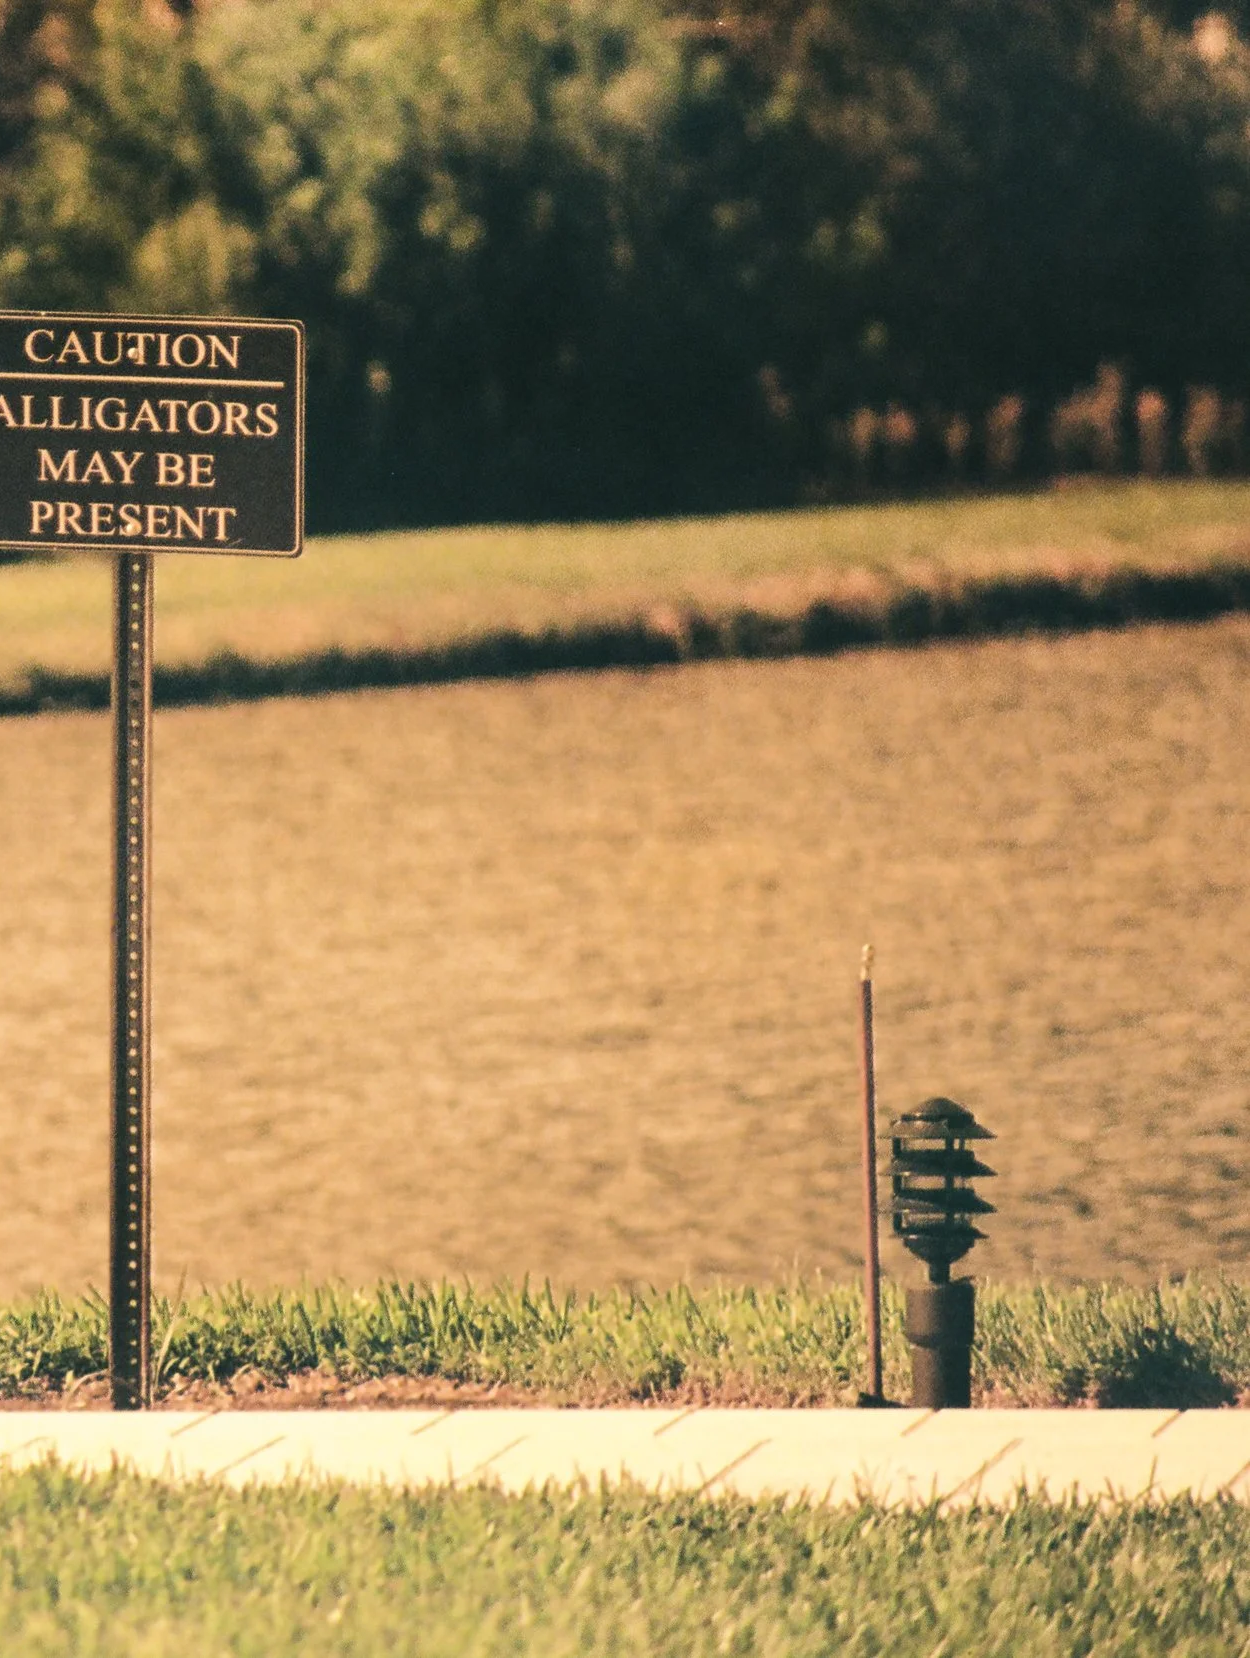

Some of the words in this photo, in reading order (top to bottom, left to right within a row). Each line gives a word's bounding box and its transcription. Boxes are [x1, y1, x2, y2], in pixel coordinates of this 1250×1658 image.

[24, 329, 242, 369] CAUTION
[37, 448, 145, 485] MAY
[155, 452, 216, 488] BE
[29, 500, 238, 542] PRESENT
